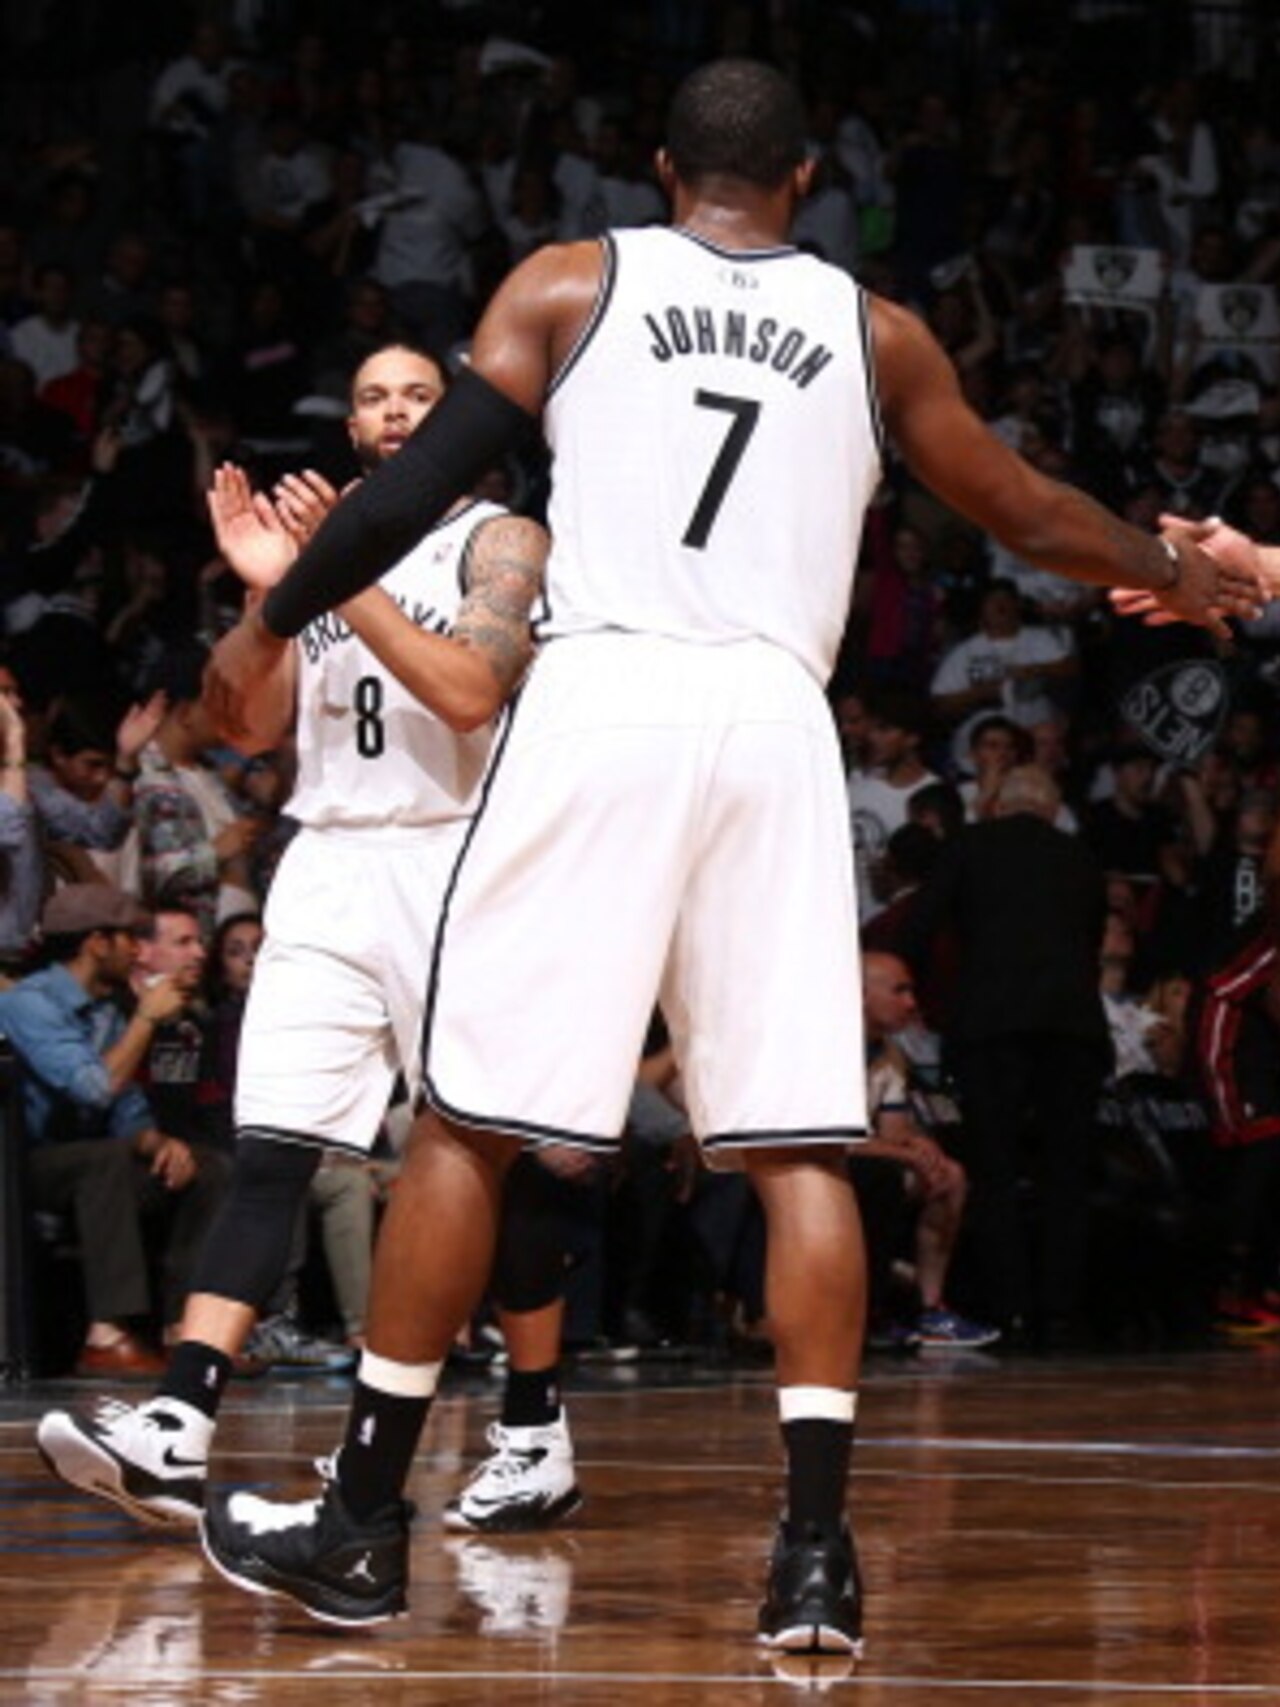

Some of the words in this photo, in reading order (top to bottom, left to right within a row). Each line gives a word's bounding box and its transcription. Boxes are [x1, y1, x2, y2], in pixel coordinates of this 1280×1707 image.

[643, 305, 834, 389] JOHNSON
[681, 387, 762, 551] 7
[354, 675, 385, 759] 8
